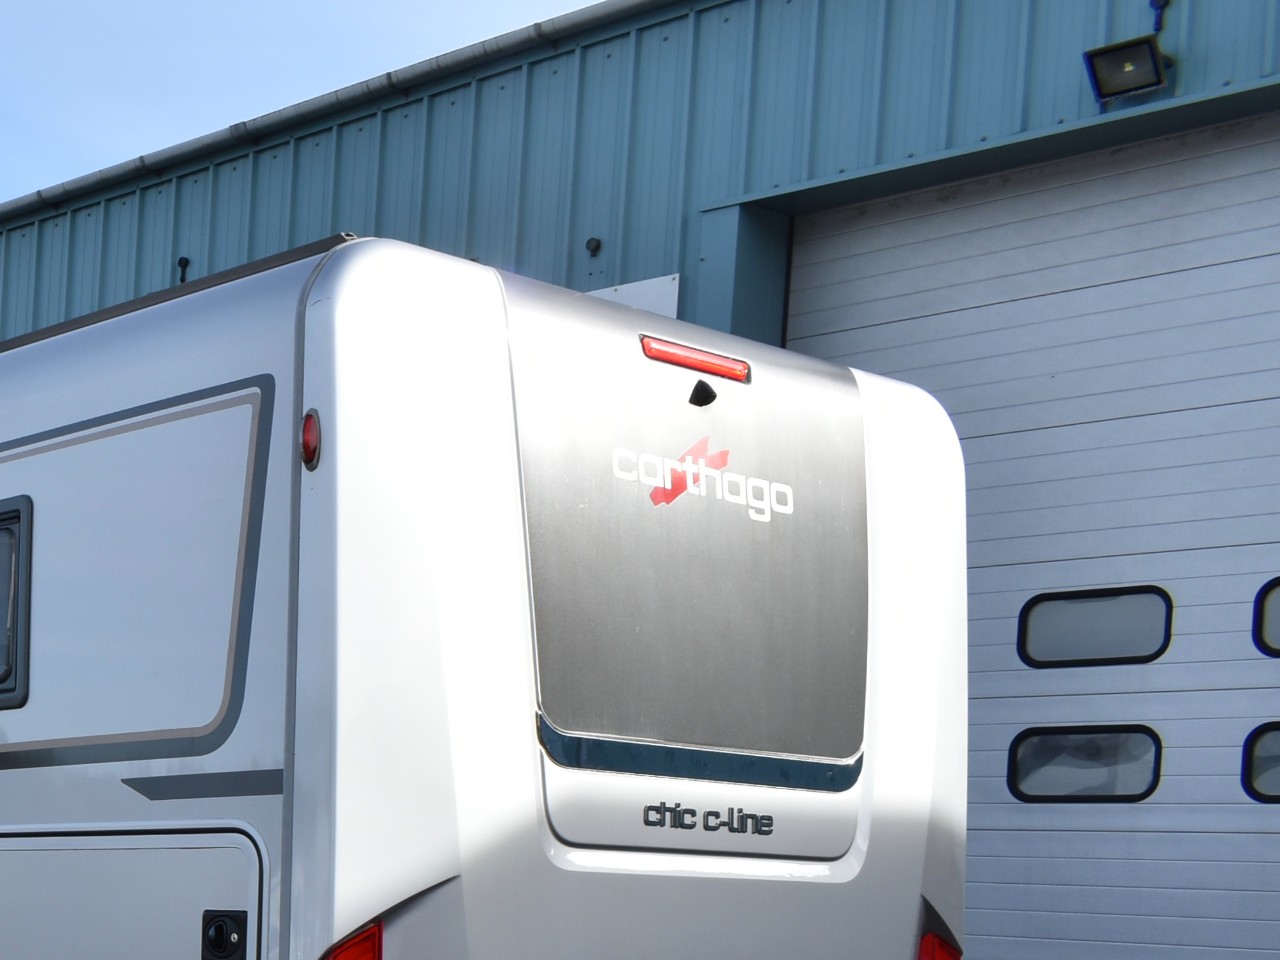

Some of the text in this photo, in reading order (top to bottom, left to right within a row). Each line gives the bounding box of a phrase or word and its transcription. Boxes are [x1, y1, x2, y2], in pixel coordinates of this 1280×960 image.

[612, 448, 794, 523] carthago
[643, 801, 774, 836] chic c-line
